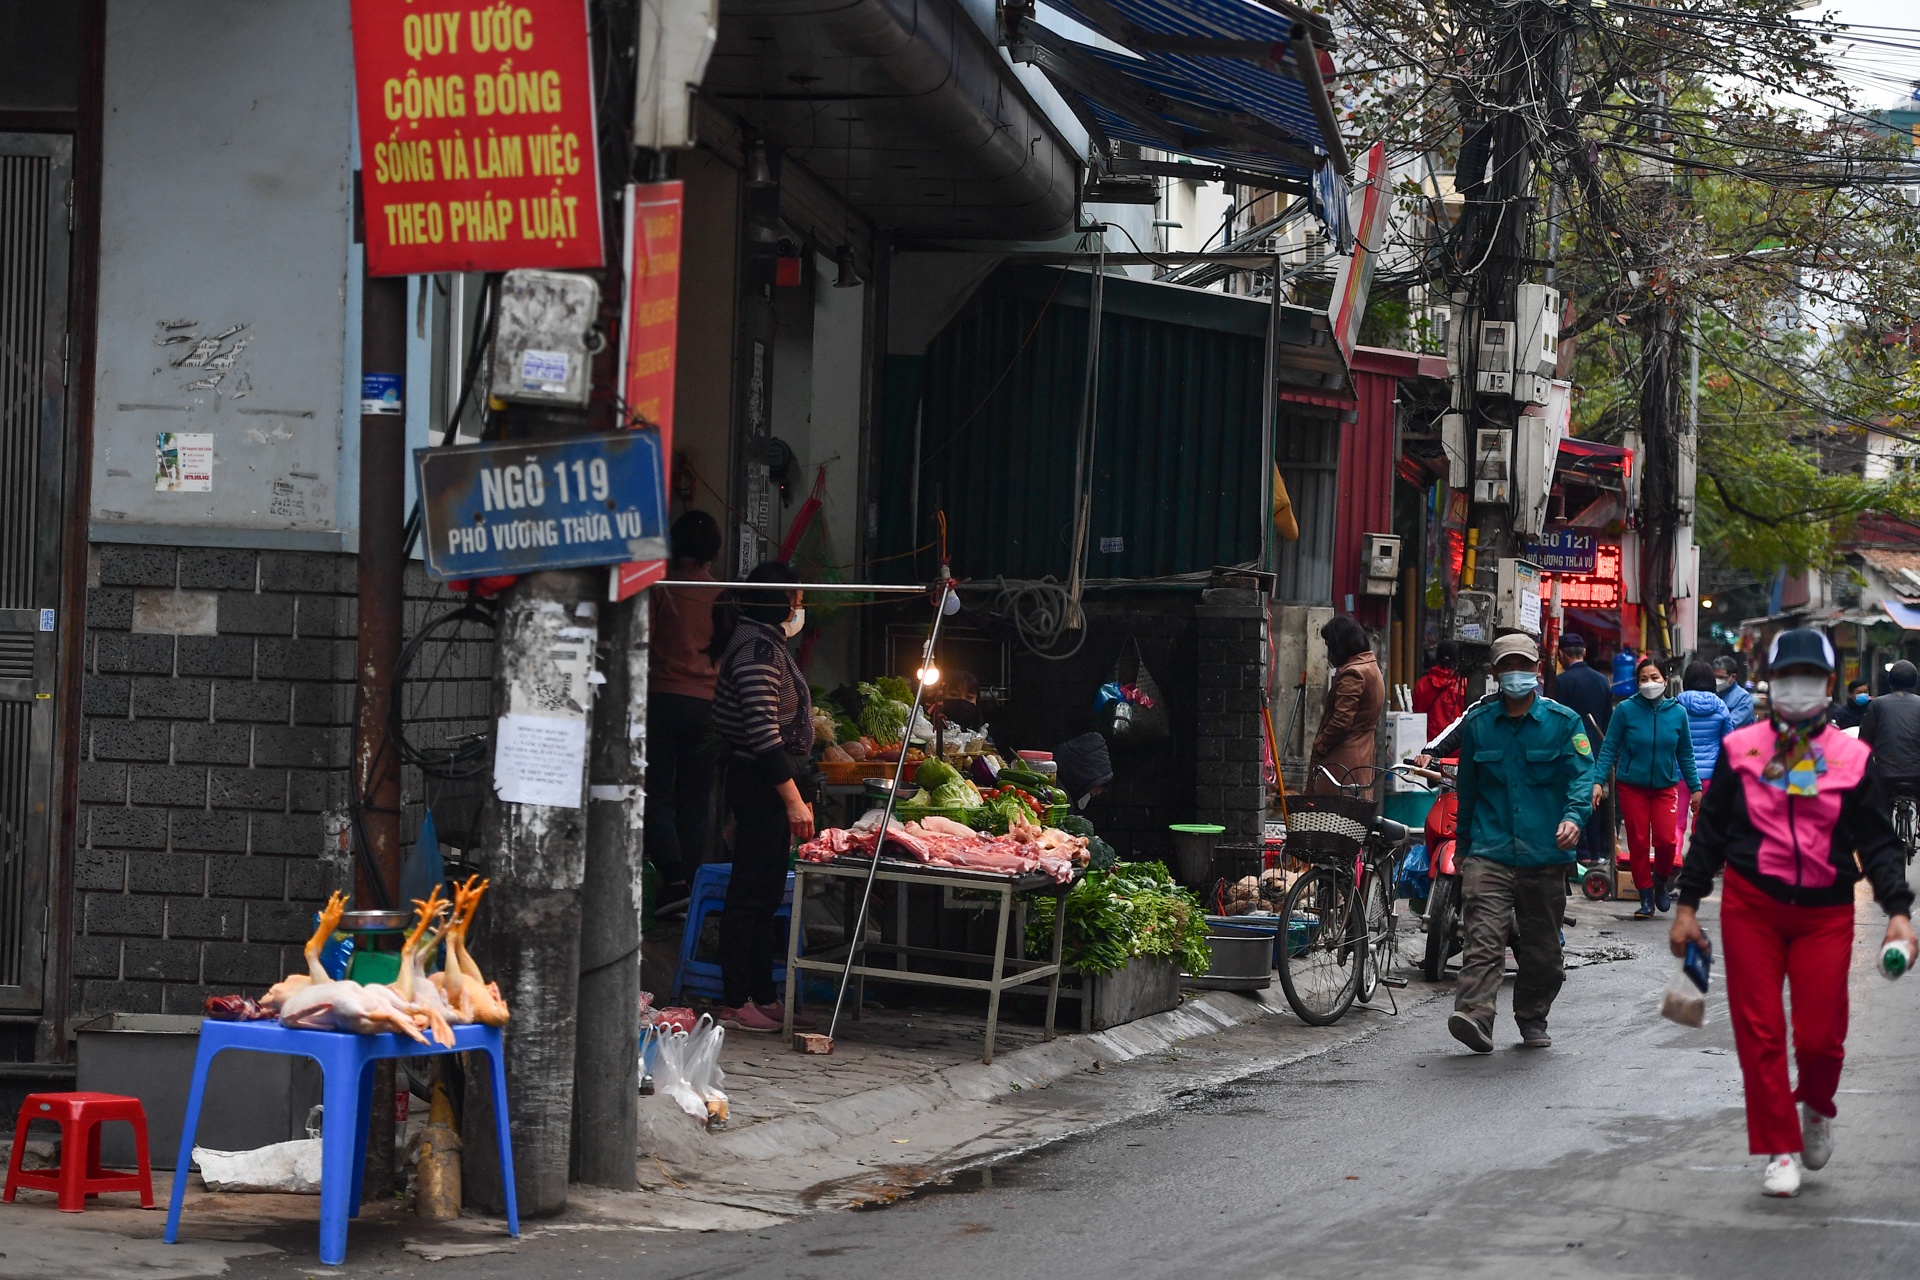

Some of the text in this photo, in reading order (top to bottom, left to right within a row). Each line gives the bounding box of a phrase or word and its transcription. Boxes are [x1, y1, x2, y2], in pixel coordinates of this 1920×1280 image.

[404, 0, 533, 61] QUY ƯỚC
[384, 58, 562, 129] CỘNG ĐỒNG
[374, 123, 580, 185] SỐNG VÀ LÀM VIỆC
[384, 202, 444, 246] THEO
[449, 190, 514, 243] PHÁP
[520, 187, 578, 248] LUẬT
[480, 455, 609, 511] NGÕ 119
[448, 505, 642, 555] PHỐ VƯƠNG THỪA VŨ
[1528, 530, 1590, 549] GÕ 121
